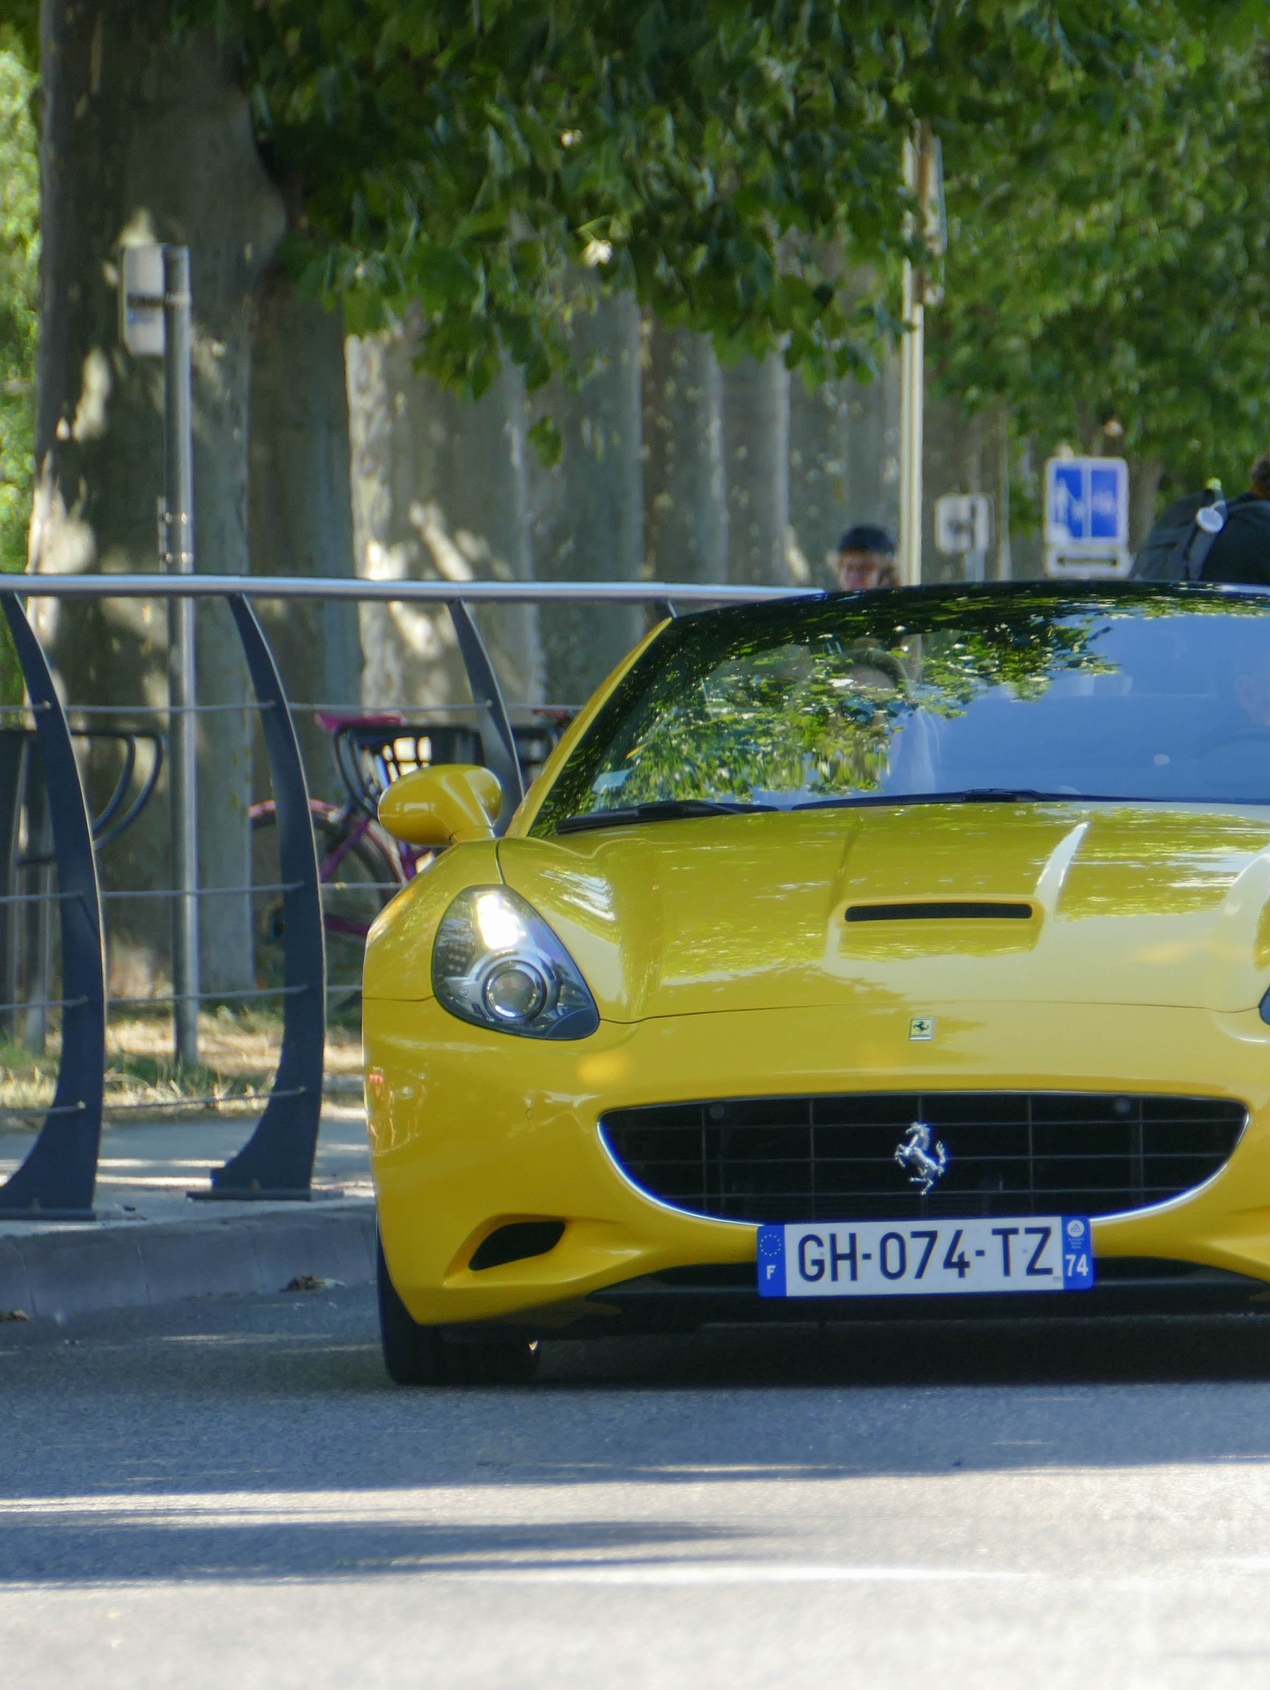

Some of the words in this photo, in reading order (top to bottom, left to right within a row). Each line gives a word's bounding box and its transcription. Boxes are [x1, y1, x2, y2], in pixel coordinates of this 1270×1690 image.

[797, 1226, 1055, 1282] GH-074-TZ
[1065, 1254, 1089, 1277] 74
[766, 1264, 776, 1280] F
